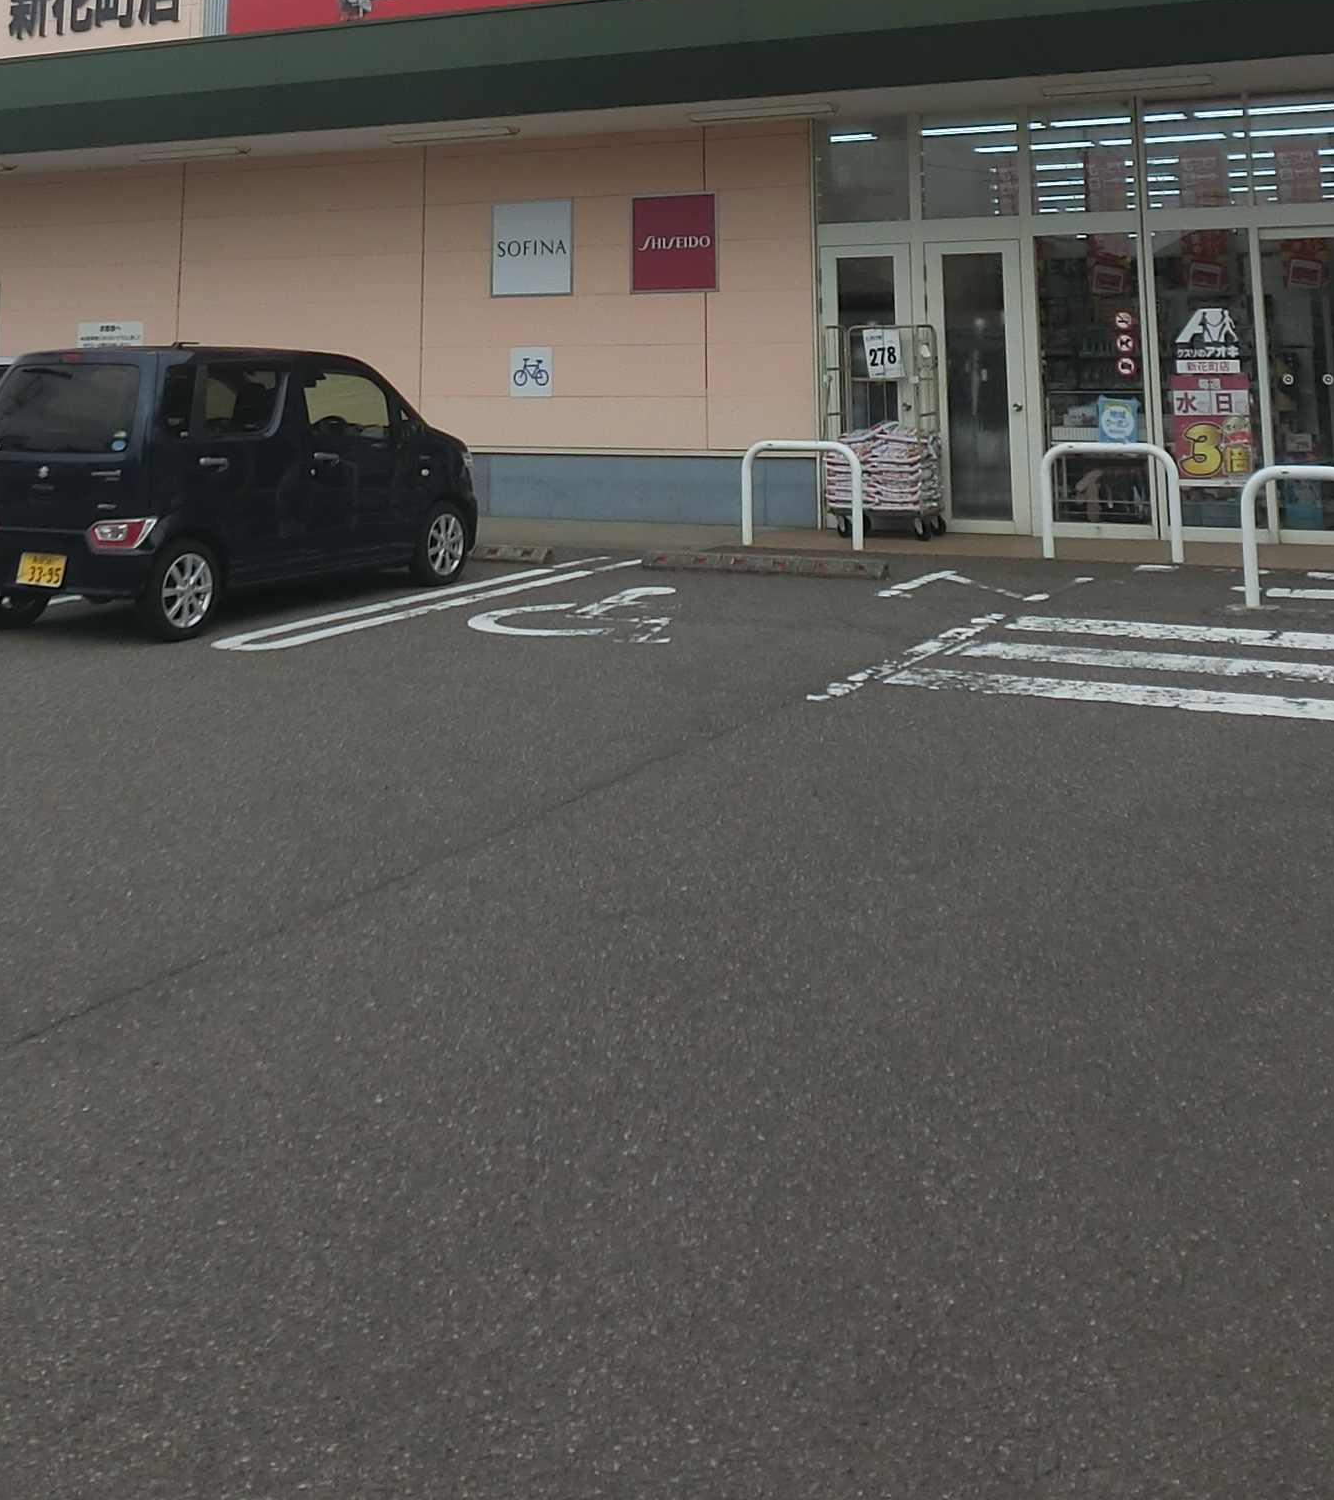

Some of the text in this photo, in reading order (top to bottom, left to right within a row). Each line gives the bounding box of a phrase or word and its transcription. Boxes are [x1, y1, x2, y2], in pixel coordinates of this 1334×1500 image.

[497, 239, 567, 258] SOFINA
[638, 234, 711, 252] SHISEIDO
[869, 346, 897, 367] 278
[1176, 346, 1240, 358] クスリのアオキ
[1176, 392, 1233, 414] 水 日
[1179, 422, 1223, 477] 3
[28, 565, 62, 584] 33-95
